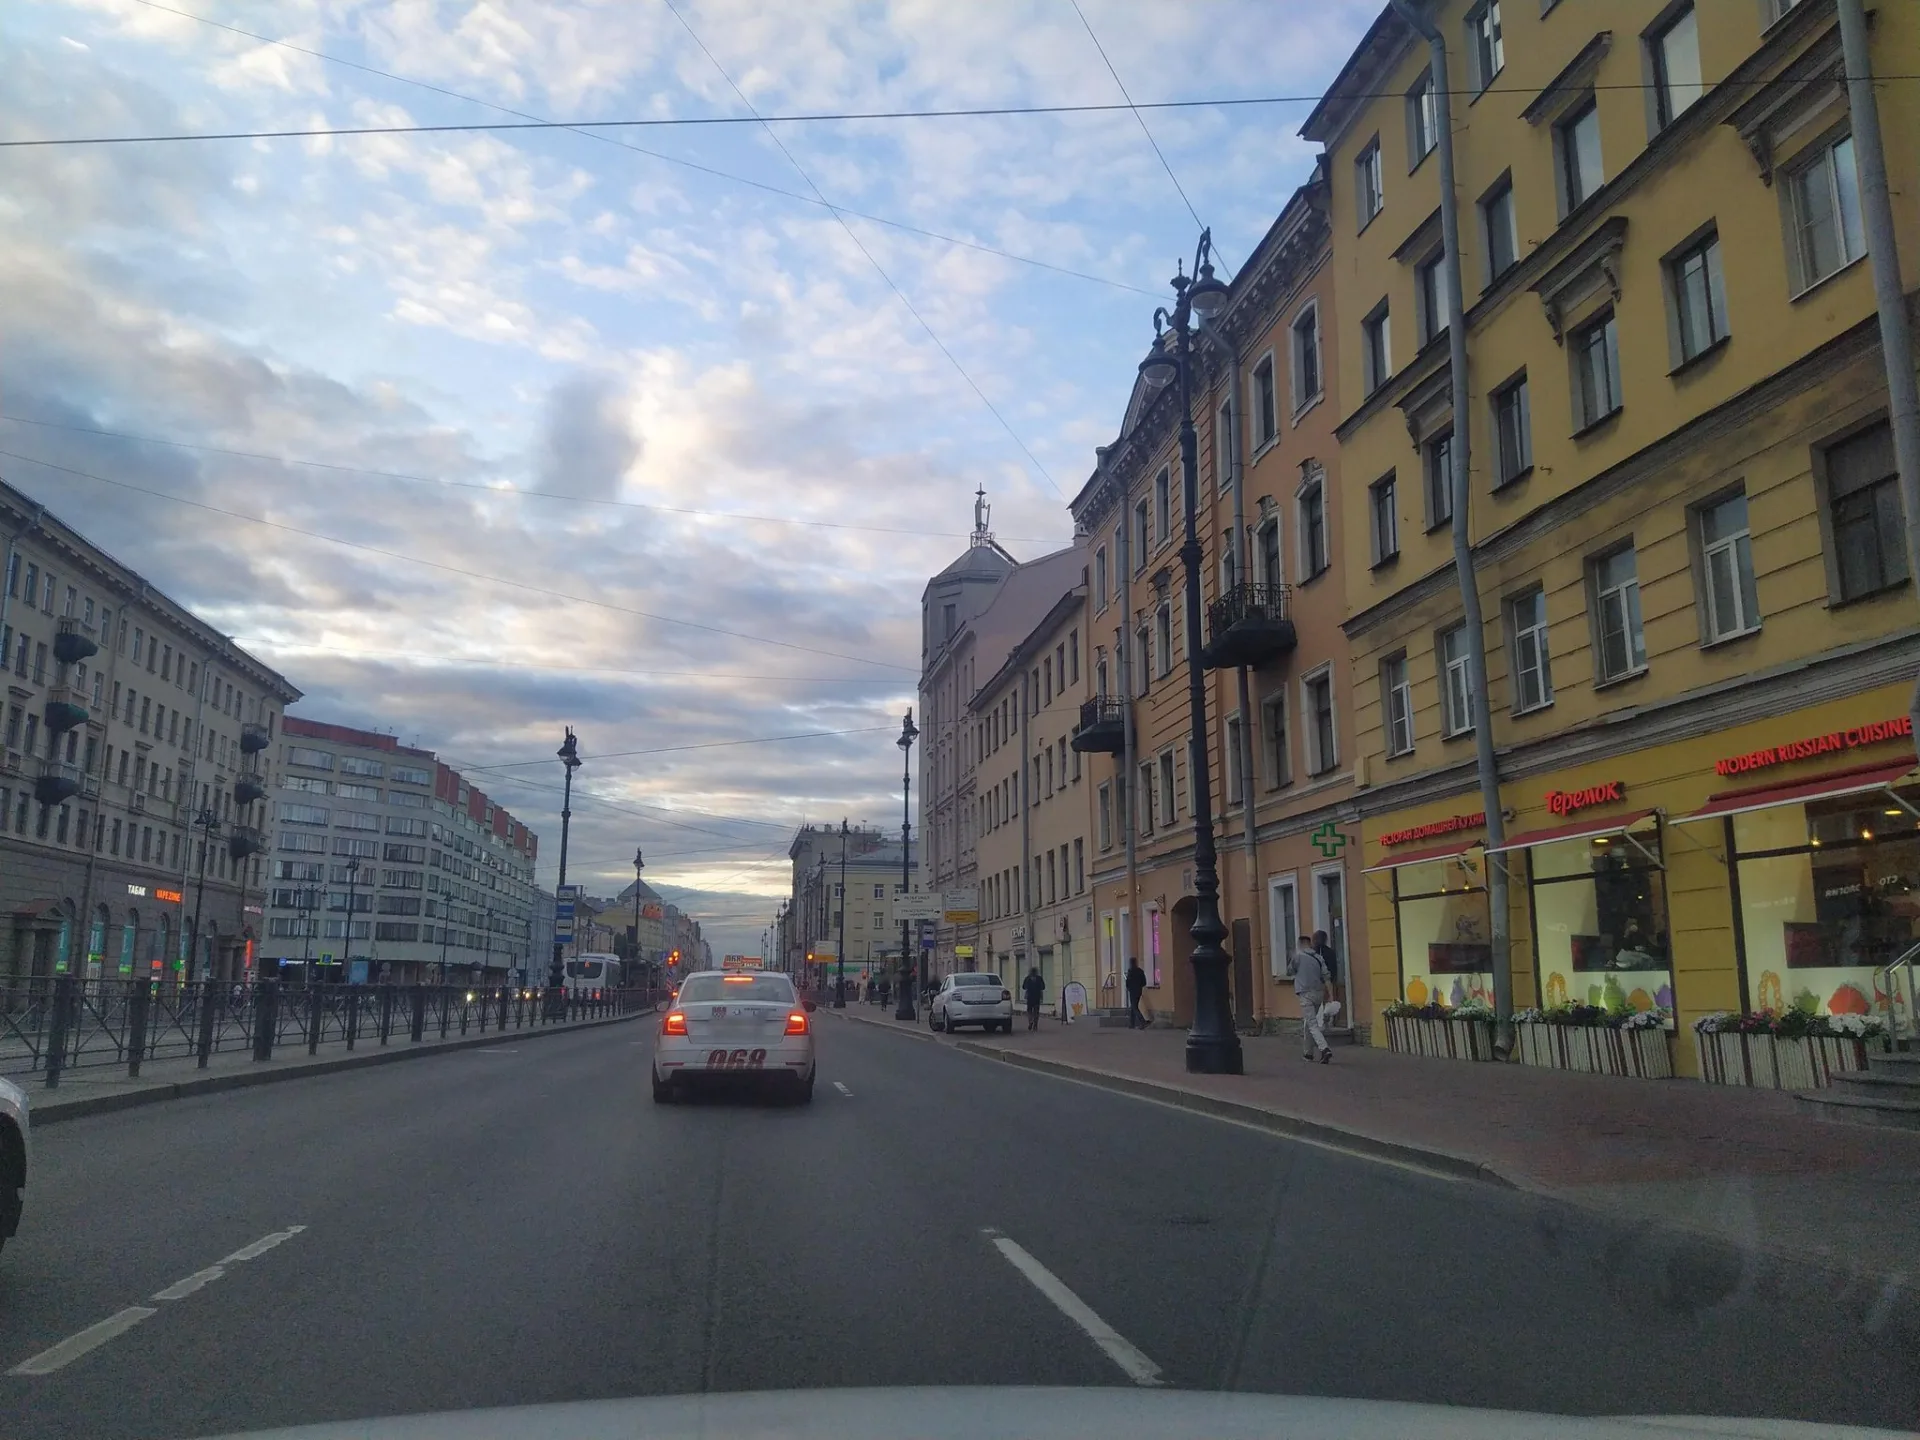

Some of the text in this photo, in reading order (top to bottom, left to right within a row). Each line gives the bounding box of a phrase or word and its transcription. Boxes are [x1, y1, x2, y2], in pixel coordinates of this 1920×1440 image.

[1715, 716, 1912, 776] MODERN RUSSIAN CUISINE
[1545, 780, 1620, 817] Теремок
[1380, 811, 1486, 846] РЕСТОРАН ДОМАШНЕЙ КУХНИ
[127, 884, 147, 897] ТАБАК
[706, 1048, 767, 1071] 068
